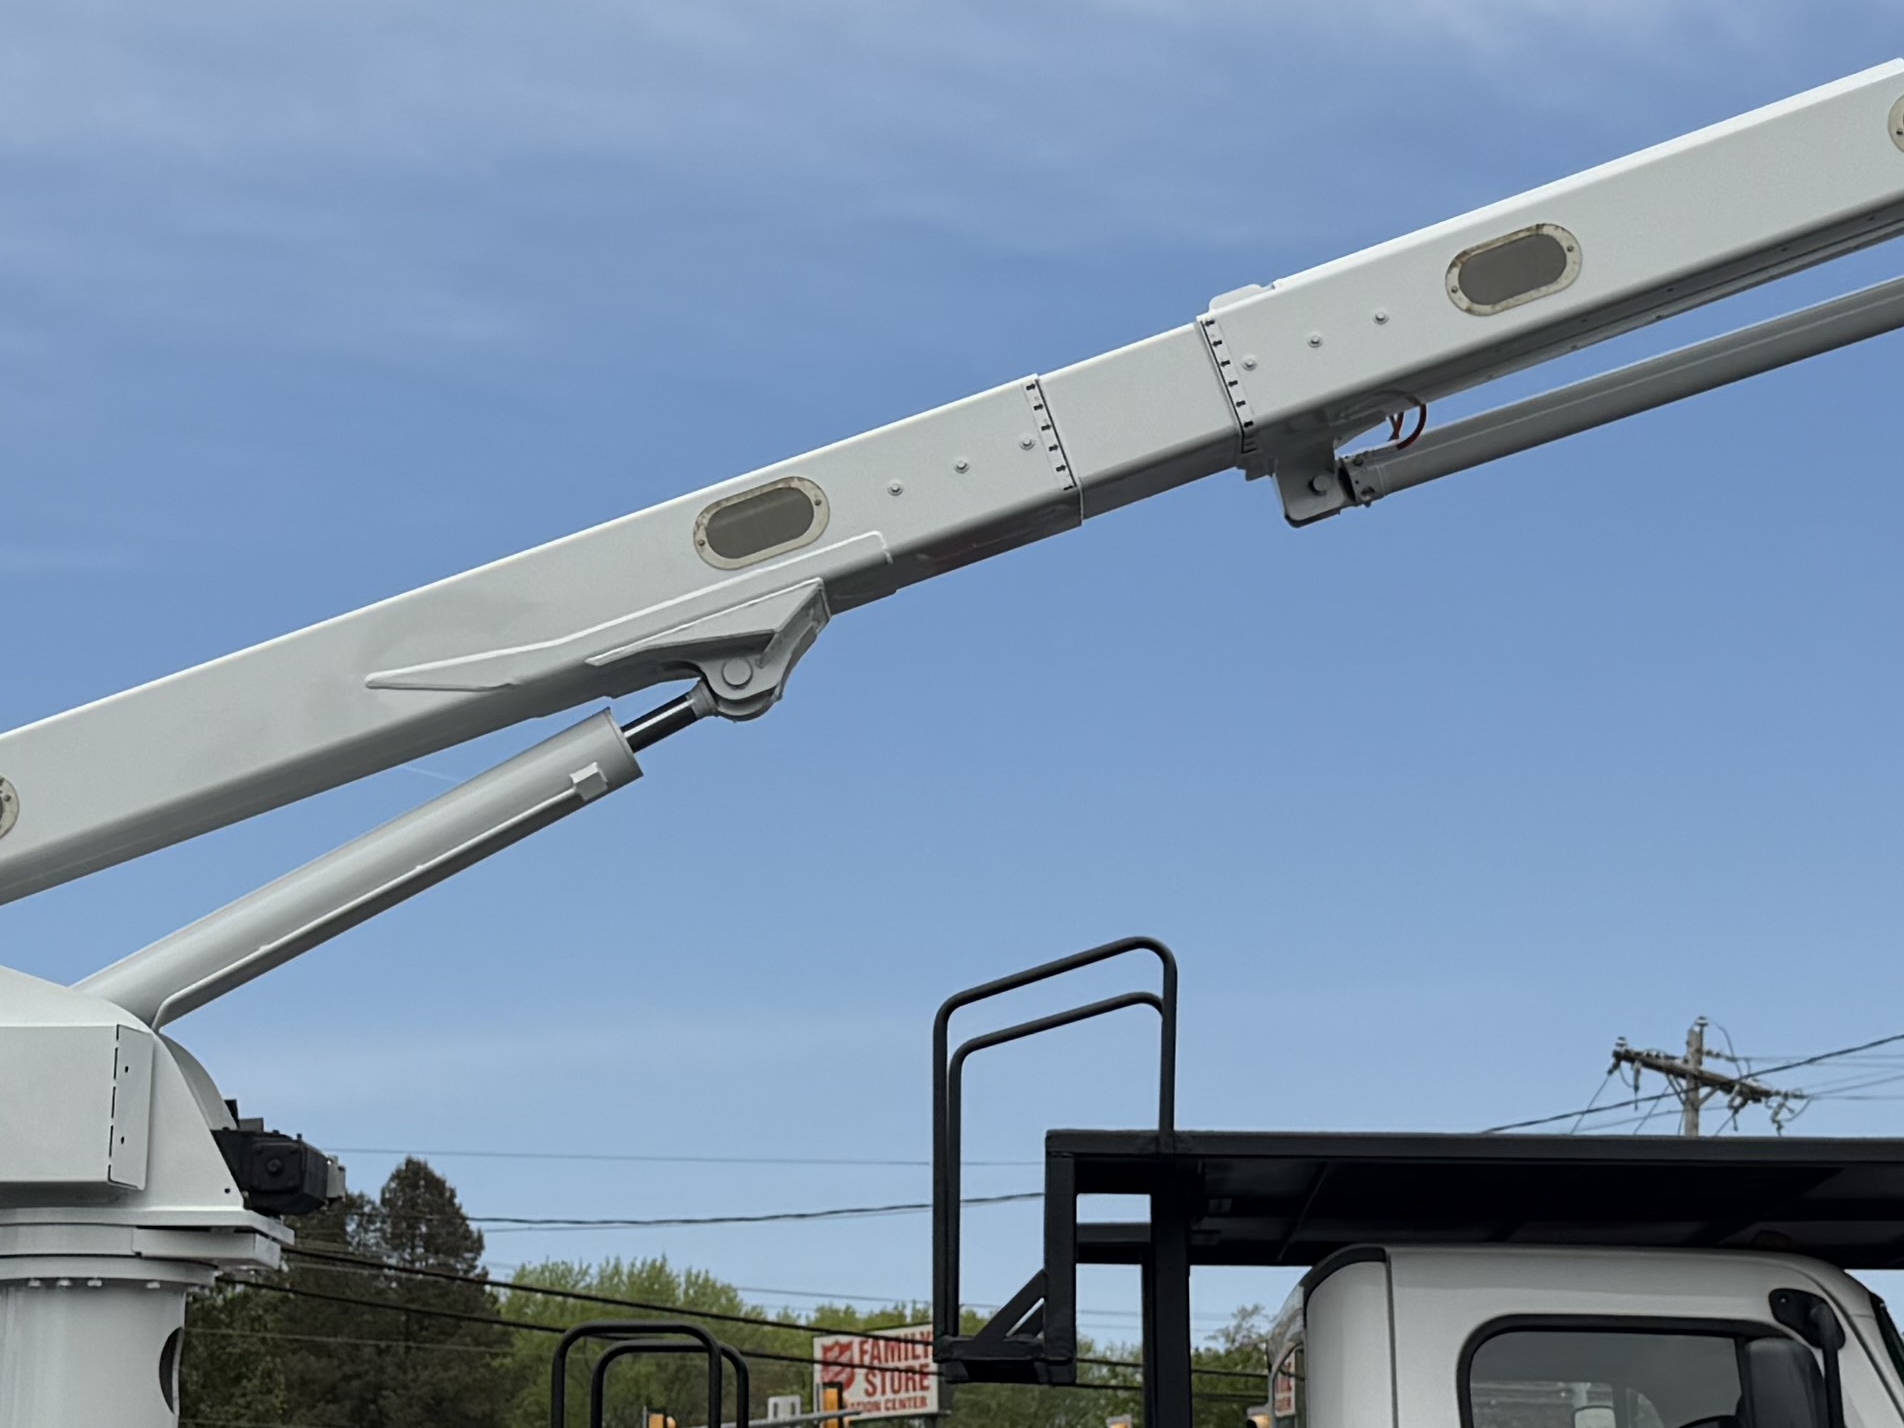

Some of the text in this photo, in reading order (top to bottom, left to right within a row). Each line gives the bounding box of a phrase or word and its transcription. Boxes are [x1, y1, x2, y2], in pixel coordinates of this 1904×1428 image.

[858, 1330, 932, 1365] FAMILY
[864, 1363, 930, 1397] STORE
[884, 1395, 929, 1412] CENTER
